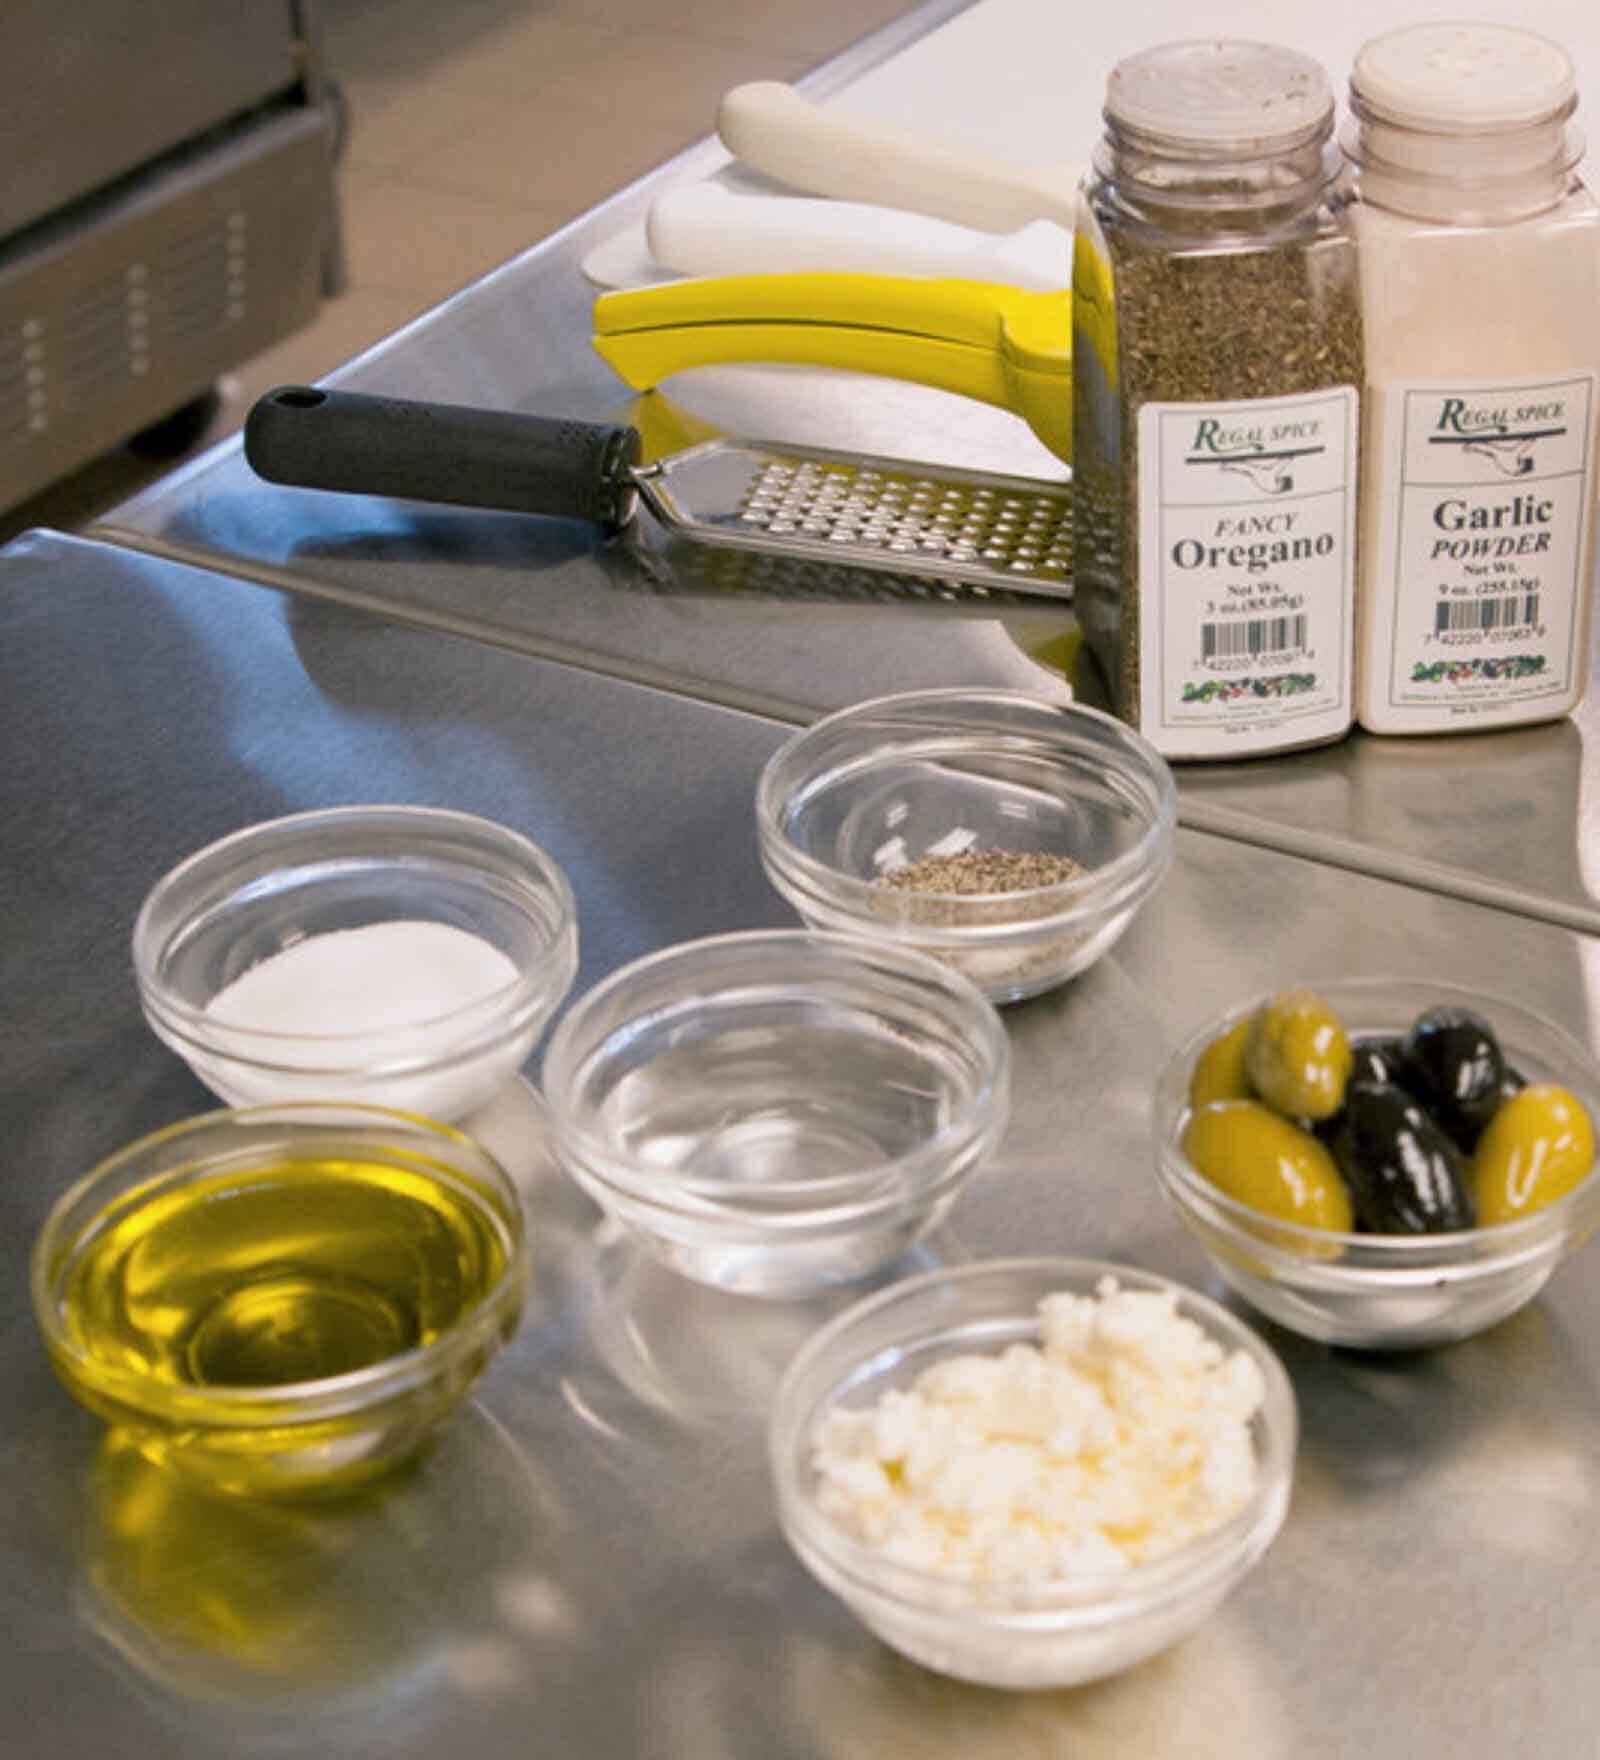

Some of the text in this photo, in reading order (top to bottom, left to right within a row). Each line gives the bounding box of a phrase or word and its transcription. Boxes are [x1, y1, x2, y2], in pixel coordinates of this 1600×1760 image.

[1513, 402, 1566, 420] SPICE
[1269, 420, 1320, 440] SPICE
[1214, 513, 1298, 537] FANCY
[1433, 494, 1553, 531] Garlic
[1172, 533, 1334, 574] Oregano
[1431, 532, 1552, 560] POWDER
